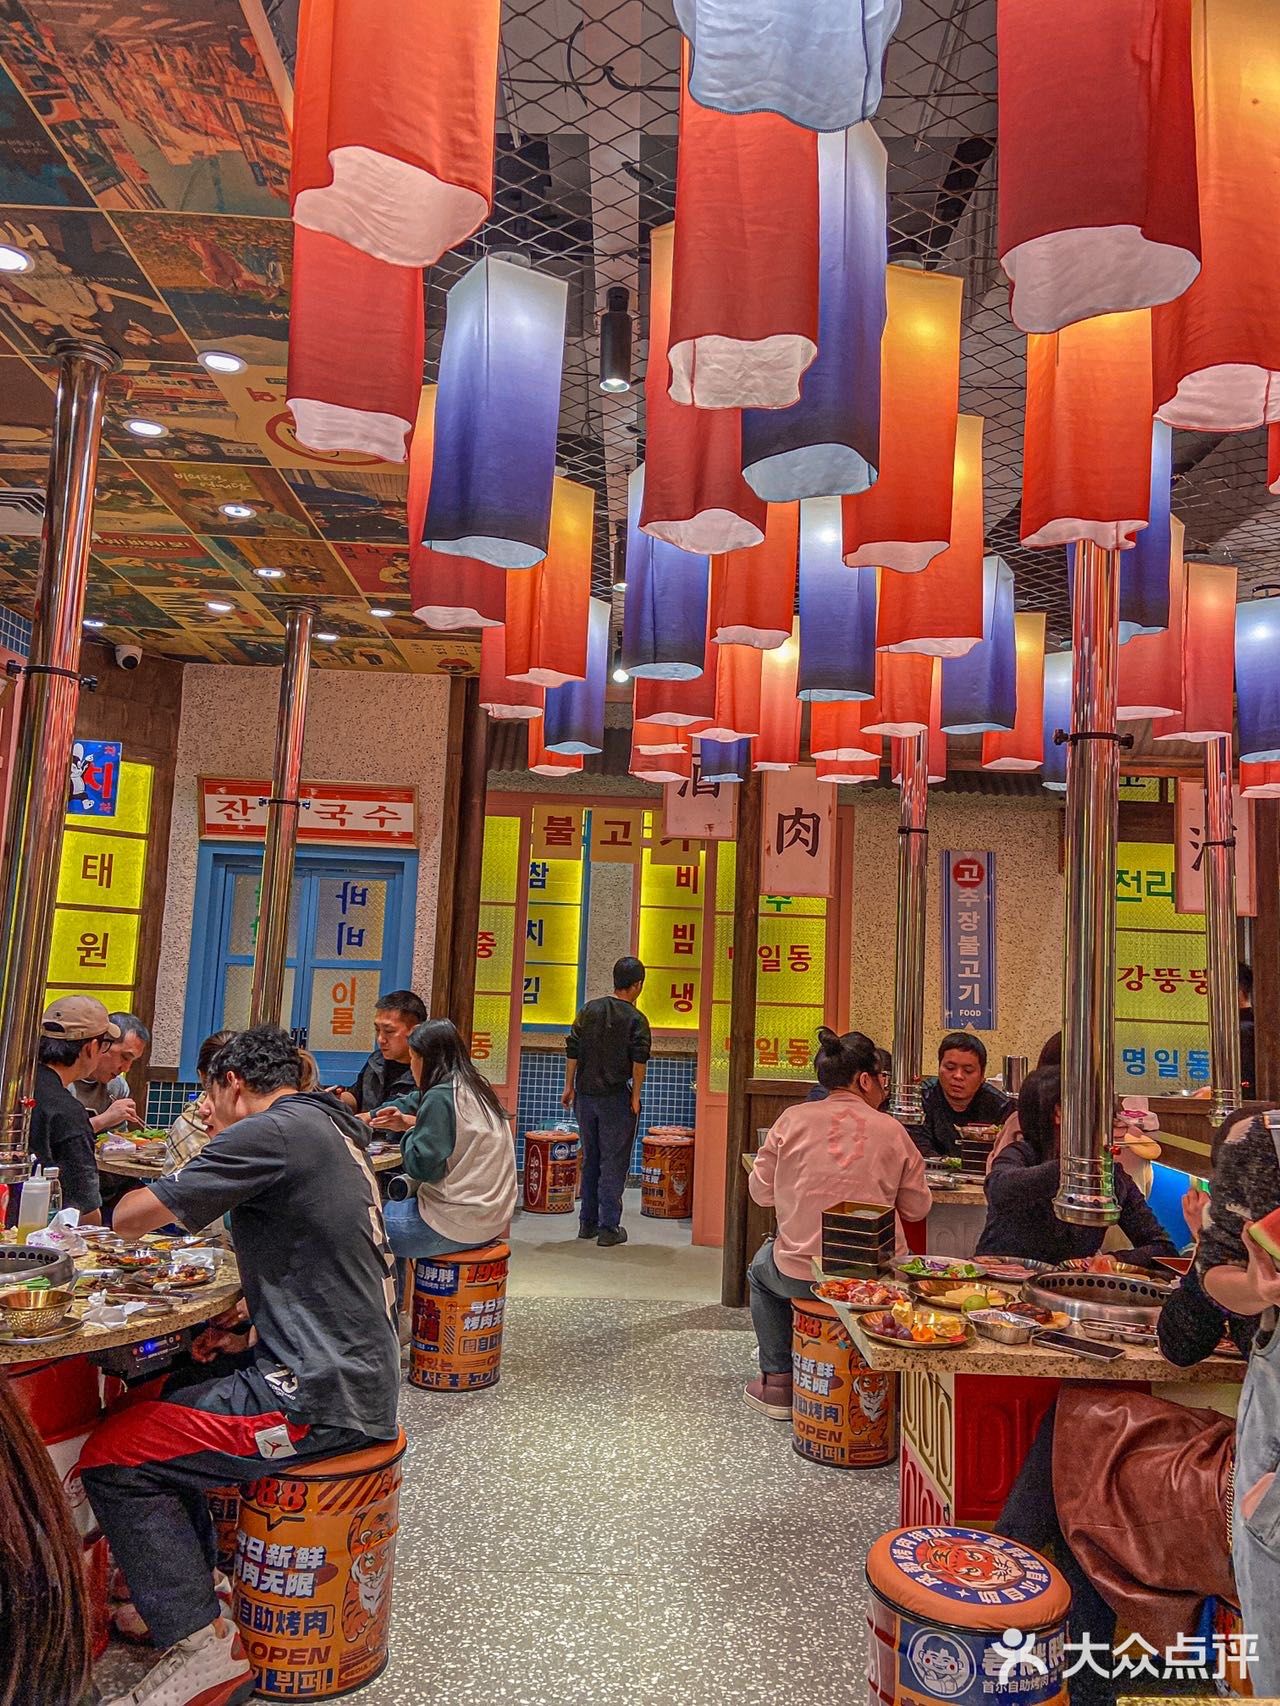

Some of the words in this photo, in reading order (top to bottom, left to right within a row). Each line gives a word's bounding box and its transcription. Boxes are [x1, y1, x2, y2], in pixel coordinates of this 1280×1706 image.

[216, 798, 402, 827] 잔국수
[776, 807, 821, 857] 肉
[728, 945, 812, 972] 일동
[959, 1009, 982, 1017] FOOD
[725, 1037, 811, 1066] 일동
[797, 1420, 842, 1443] OPEN
[237, 1557, 316, 1598] 肉无限
[252, 1642, 332, 1666] OPEN
